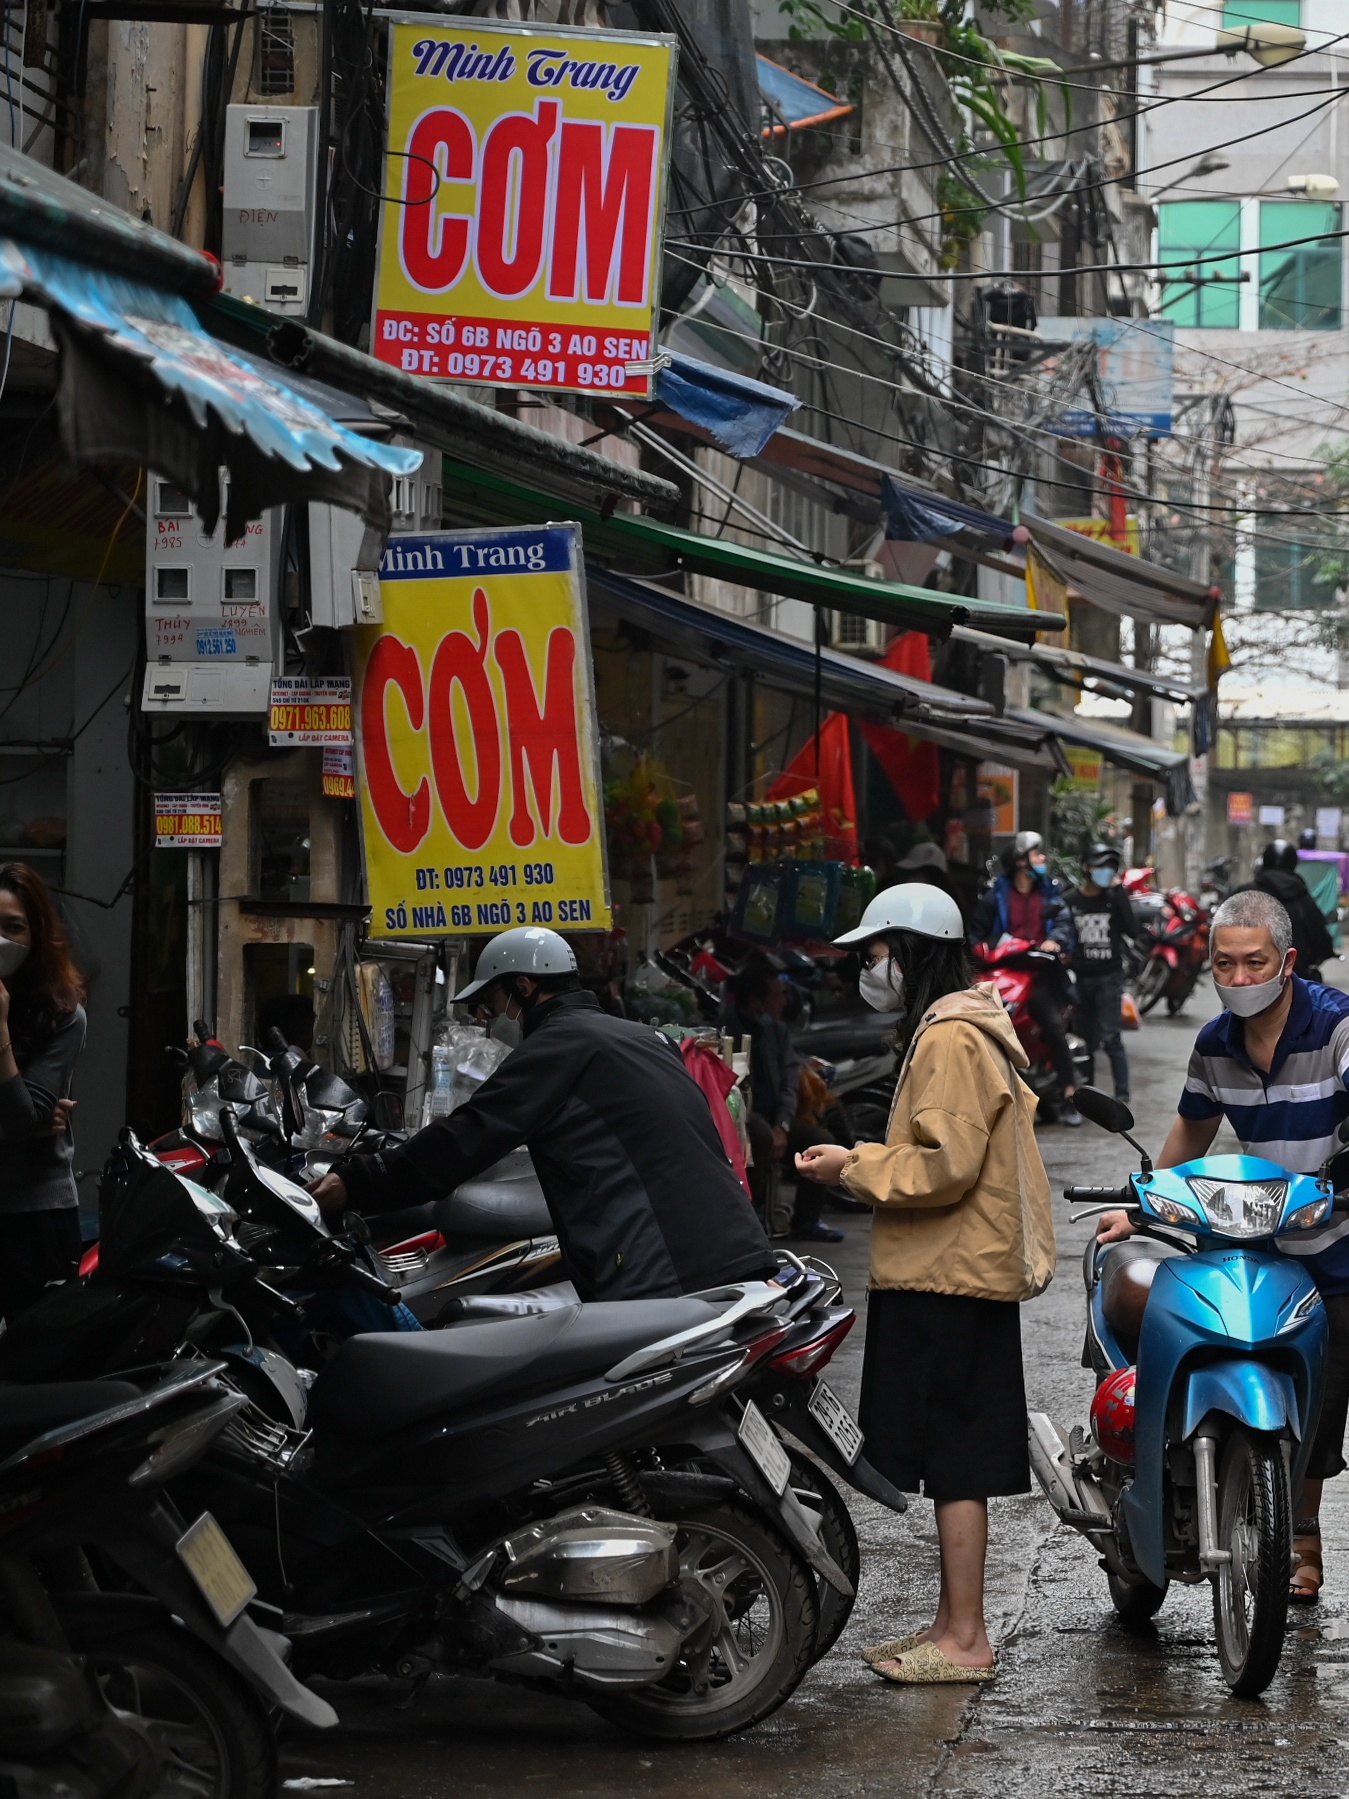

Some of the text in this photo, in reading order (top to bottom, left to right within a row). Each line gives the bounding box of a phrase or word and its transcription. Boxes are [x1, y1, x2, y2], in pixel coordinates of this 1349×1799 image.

[412, 39, 642, 101] Minh Trang
[239, 208, 278, 226] ĐIỆN
[400, 98, 659, 304] CƠM
[383, 318, 647, 360] ĐC: SỐ 6B NGÕ 3 AO SEN
[401, 349, 626, 387] ĐT: 0973 491 930
[453, 542, 546, 571] Trang
[271, 705, 351, 730] 0971.963.608
[361, 586, 592, 855] CƠM
[415, 863, 554, 891] ĐT: 0973 491 930
[385, 898, 592, 930] SỐ NHÀ 6B NGÕ 3 AO SEN
[1222, 1255, 1261, 1265] HONDA
[582, 1372, 673, 1408] BLADE
